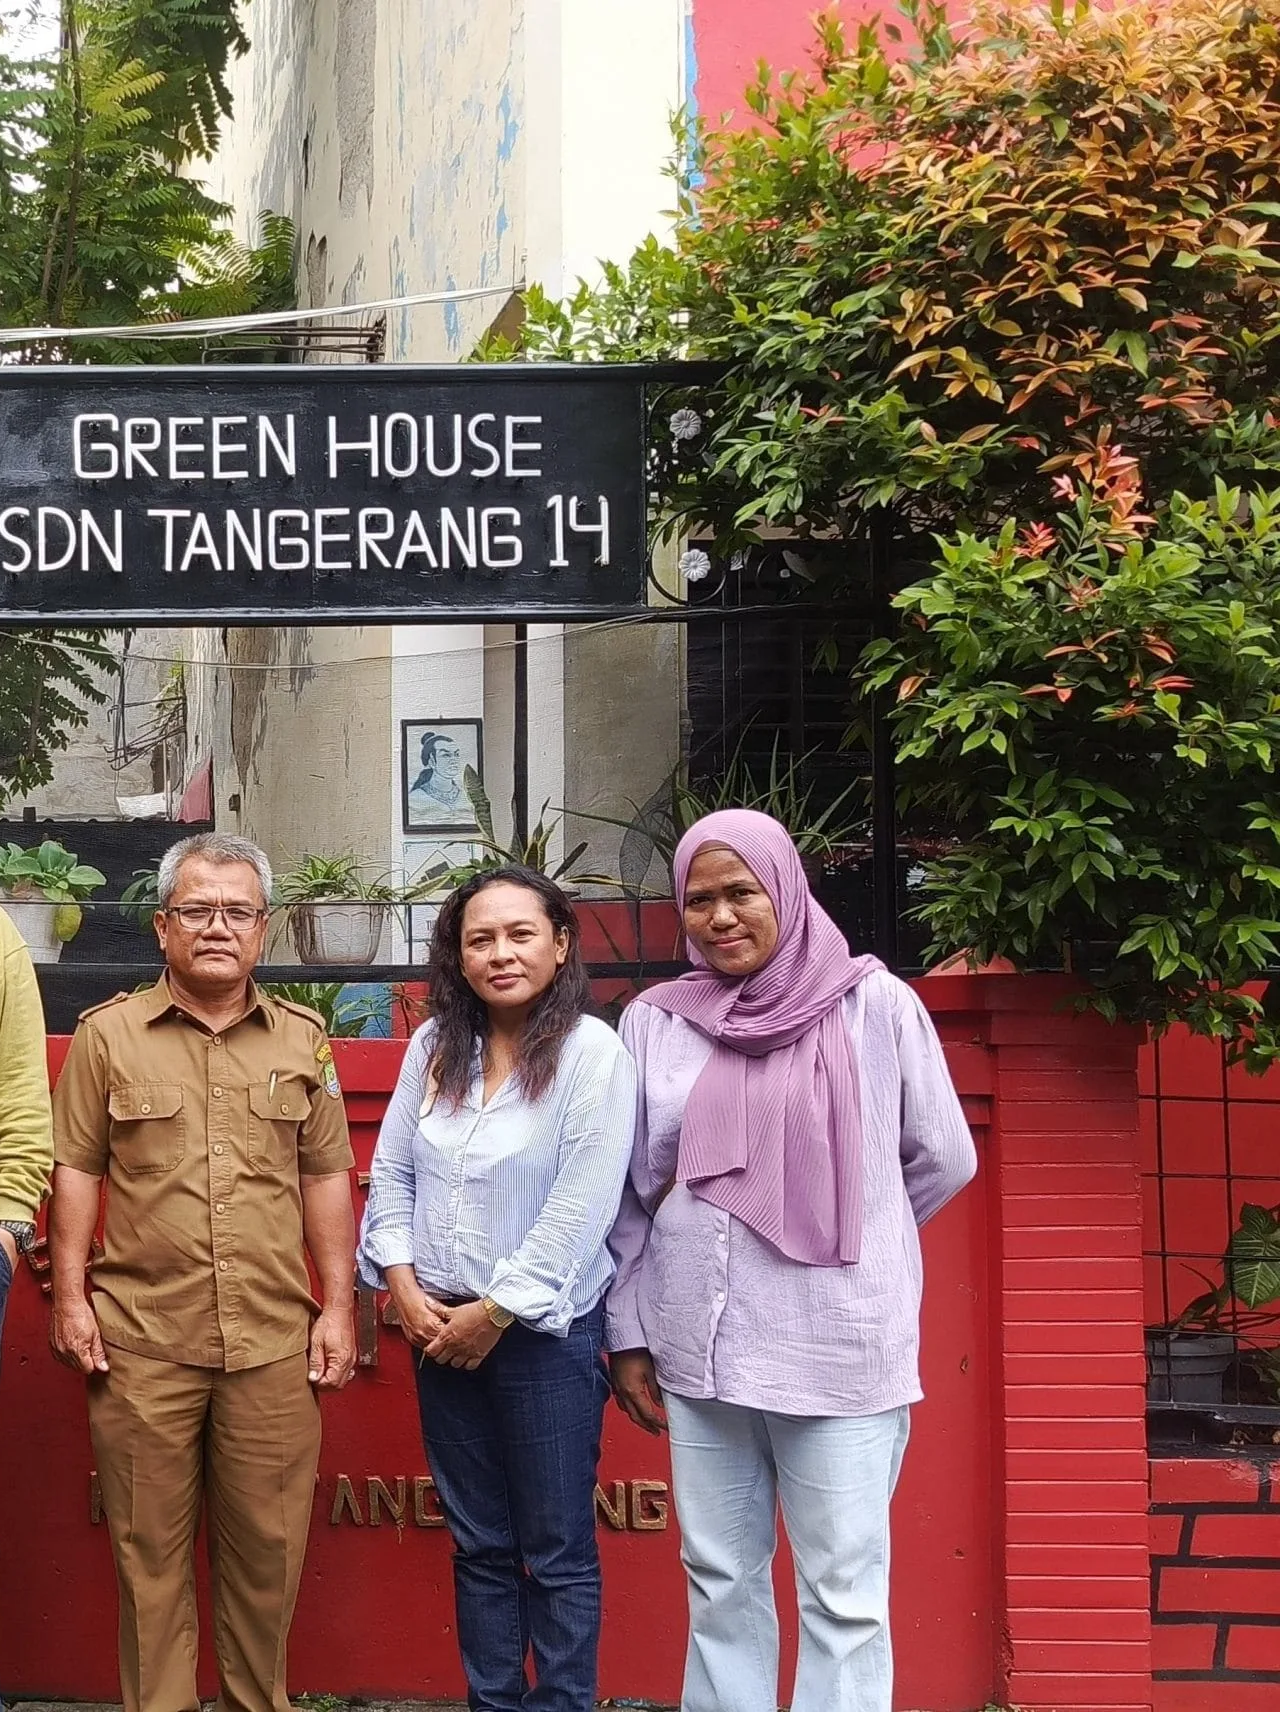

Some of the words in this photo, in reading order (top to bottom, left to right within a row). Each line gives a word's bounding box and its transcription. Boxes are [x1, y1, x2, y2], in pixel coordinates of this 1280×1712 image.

[72, 412, 297, 481] GREEN
[328, 412, 543, 480] HOUSE
[146, 505, 524, 573] TANGERANG
[546, 493, 611, 568] 14
